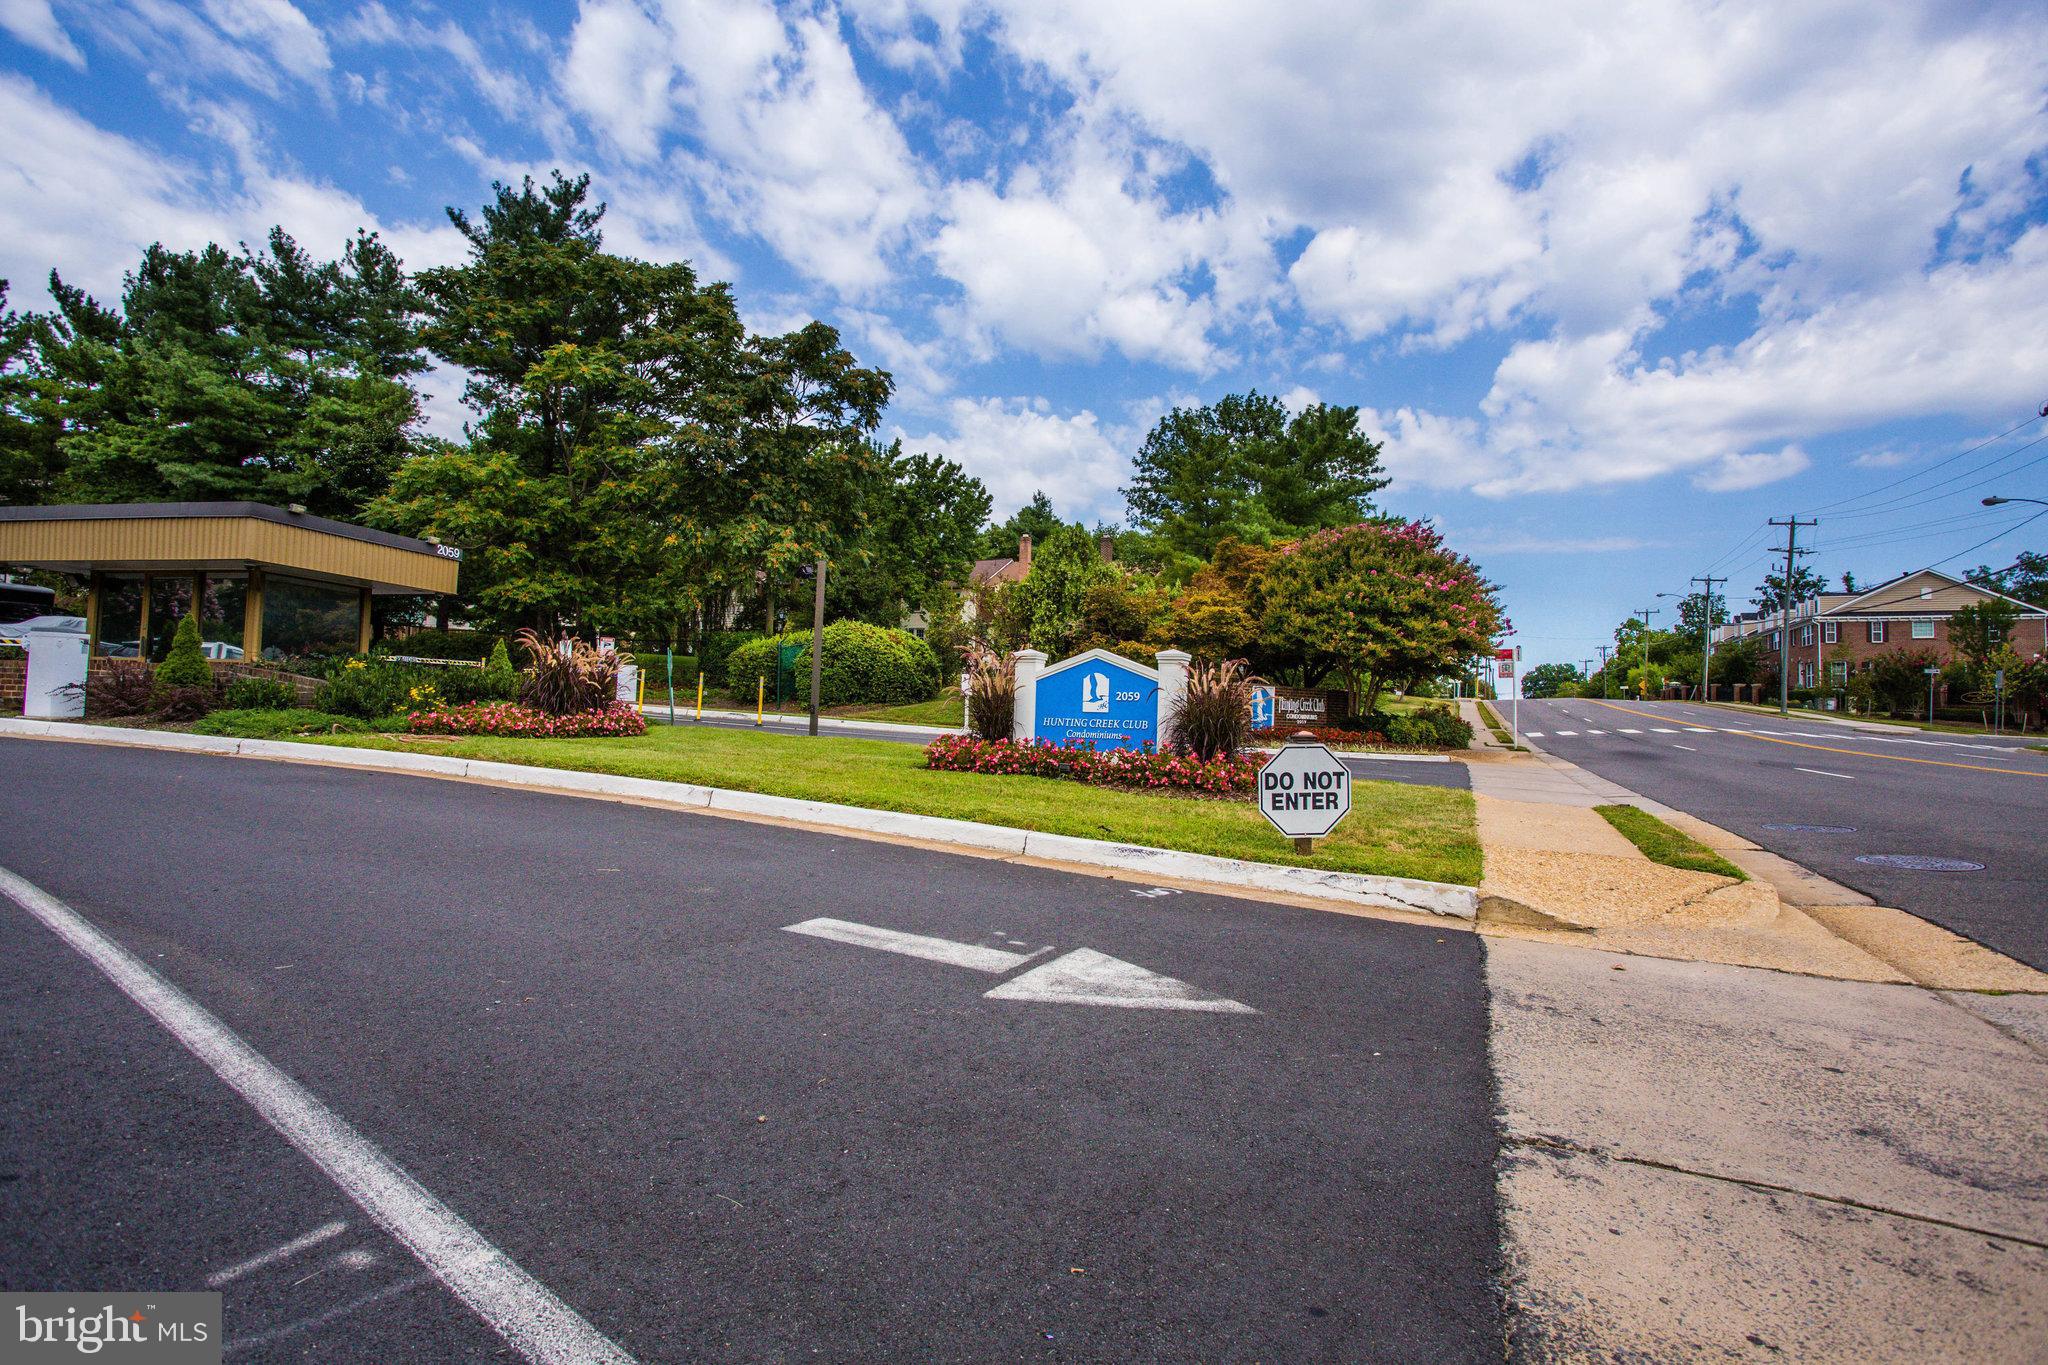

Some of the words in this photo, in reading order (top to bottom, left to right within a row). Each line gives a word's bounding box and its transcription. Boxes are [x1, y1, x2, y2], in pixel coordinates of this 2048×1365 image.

[437, 544, 460, 558] 2059
[1115, 691, 1140, 701] 2059
[1043, 717, 1088, 728] HUNTING
[1089, 718, 1121, 729] CREEK
[1122, 719, 1149, 730] CLUB
[1066, 729, 1123, 740] Condominiums
[1264, 771, 1295, 791] DO
[1303, 771, 1345, 790] NOT
[1271, 791, 1339, 811] ENTER
